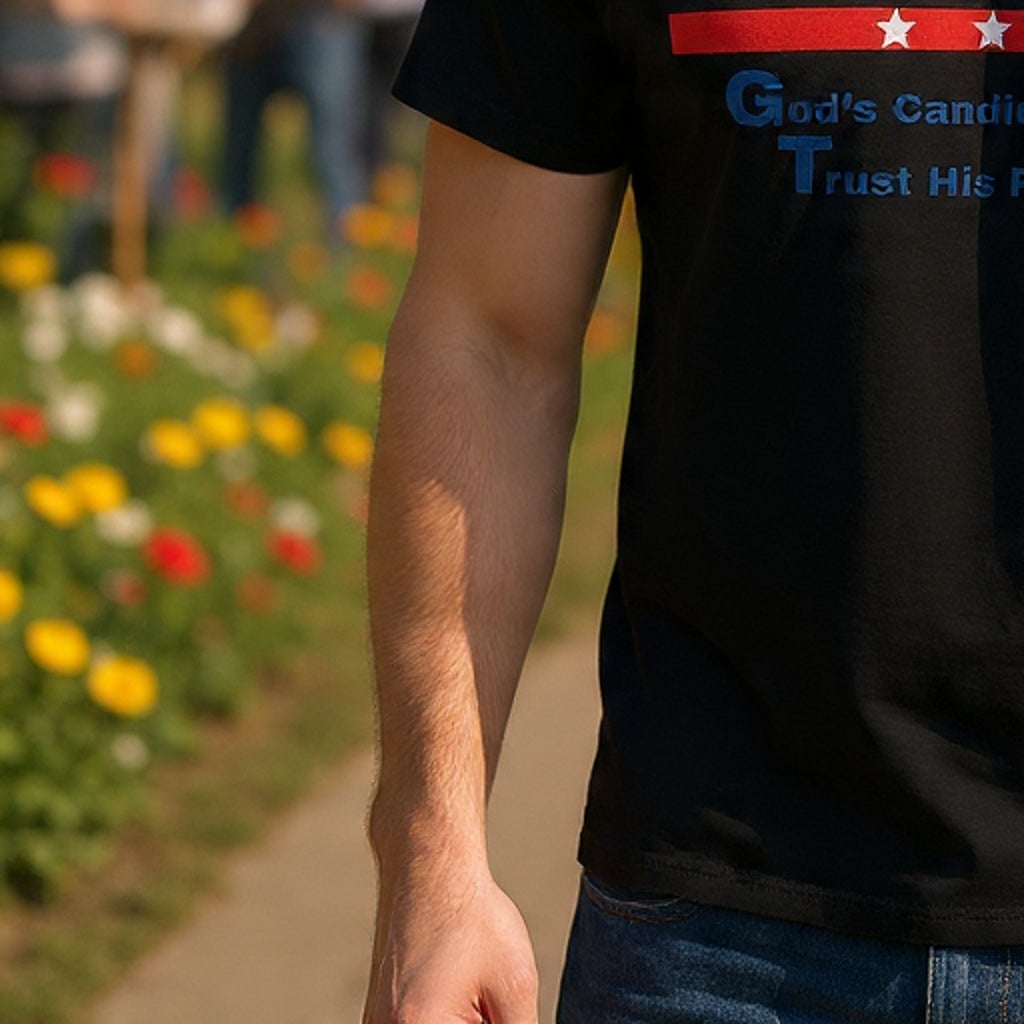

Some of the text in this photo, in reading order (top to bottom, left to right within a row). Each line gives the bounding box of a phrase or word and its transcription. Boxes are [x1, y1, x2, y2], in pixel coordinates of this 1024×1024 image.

[725, 69, 878, 128] God's
[778, 135, 912, 197] Trust
[928, 166, 994, 199] His
